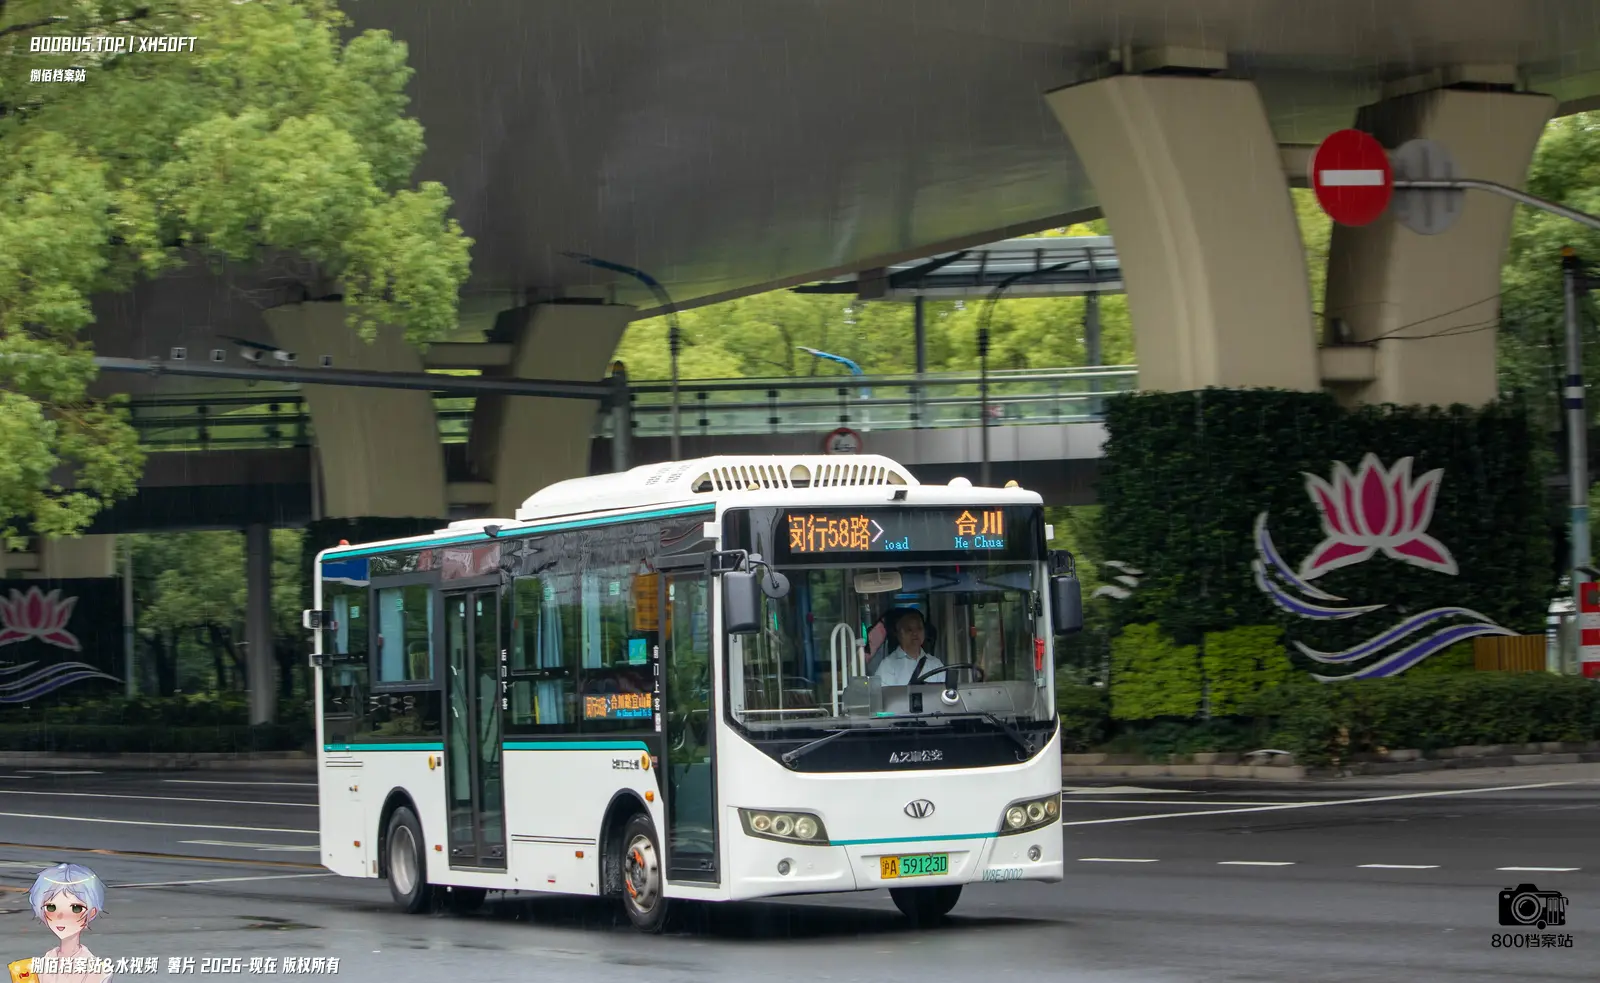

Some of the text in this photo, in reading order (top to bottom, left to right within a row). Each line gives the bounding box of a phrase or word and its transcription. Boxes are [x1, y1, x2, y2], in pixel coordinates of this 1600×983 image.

[788, 514, 872, 552] 闵行58路
[955, 510, 1003, 536] 合川
[954, 536, 969, 549] He
[974, 535, 1004, 548] Chua
[882, 855, 948, 876] 沪A 59123D
[982, 868, 1024, 881] W8E-0002
